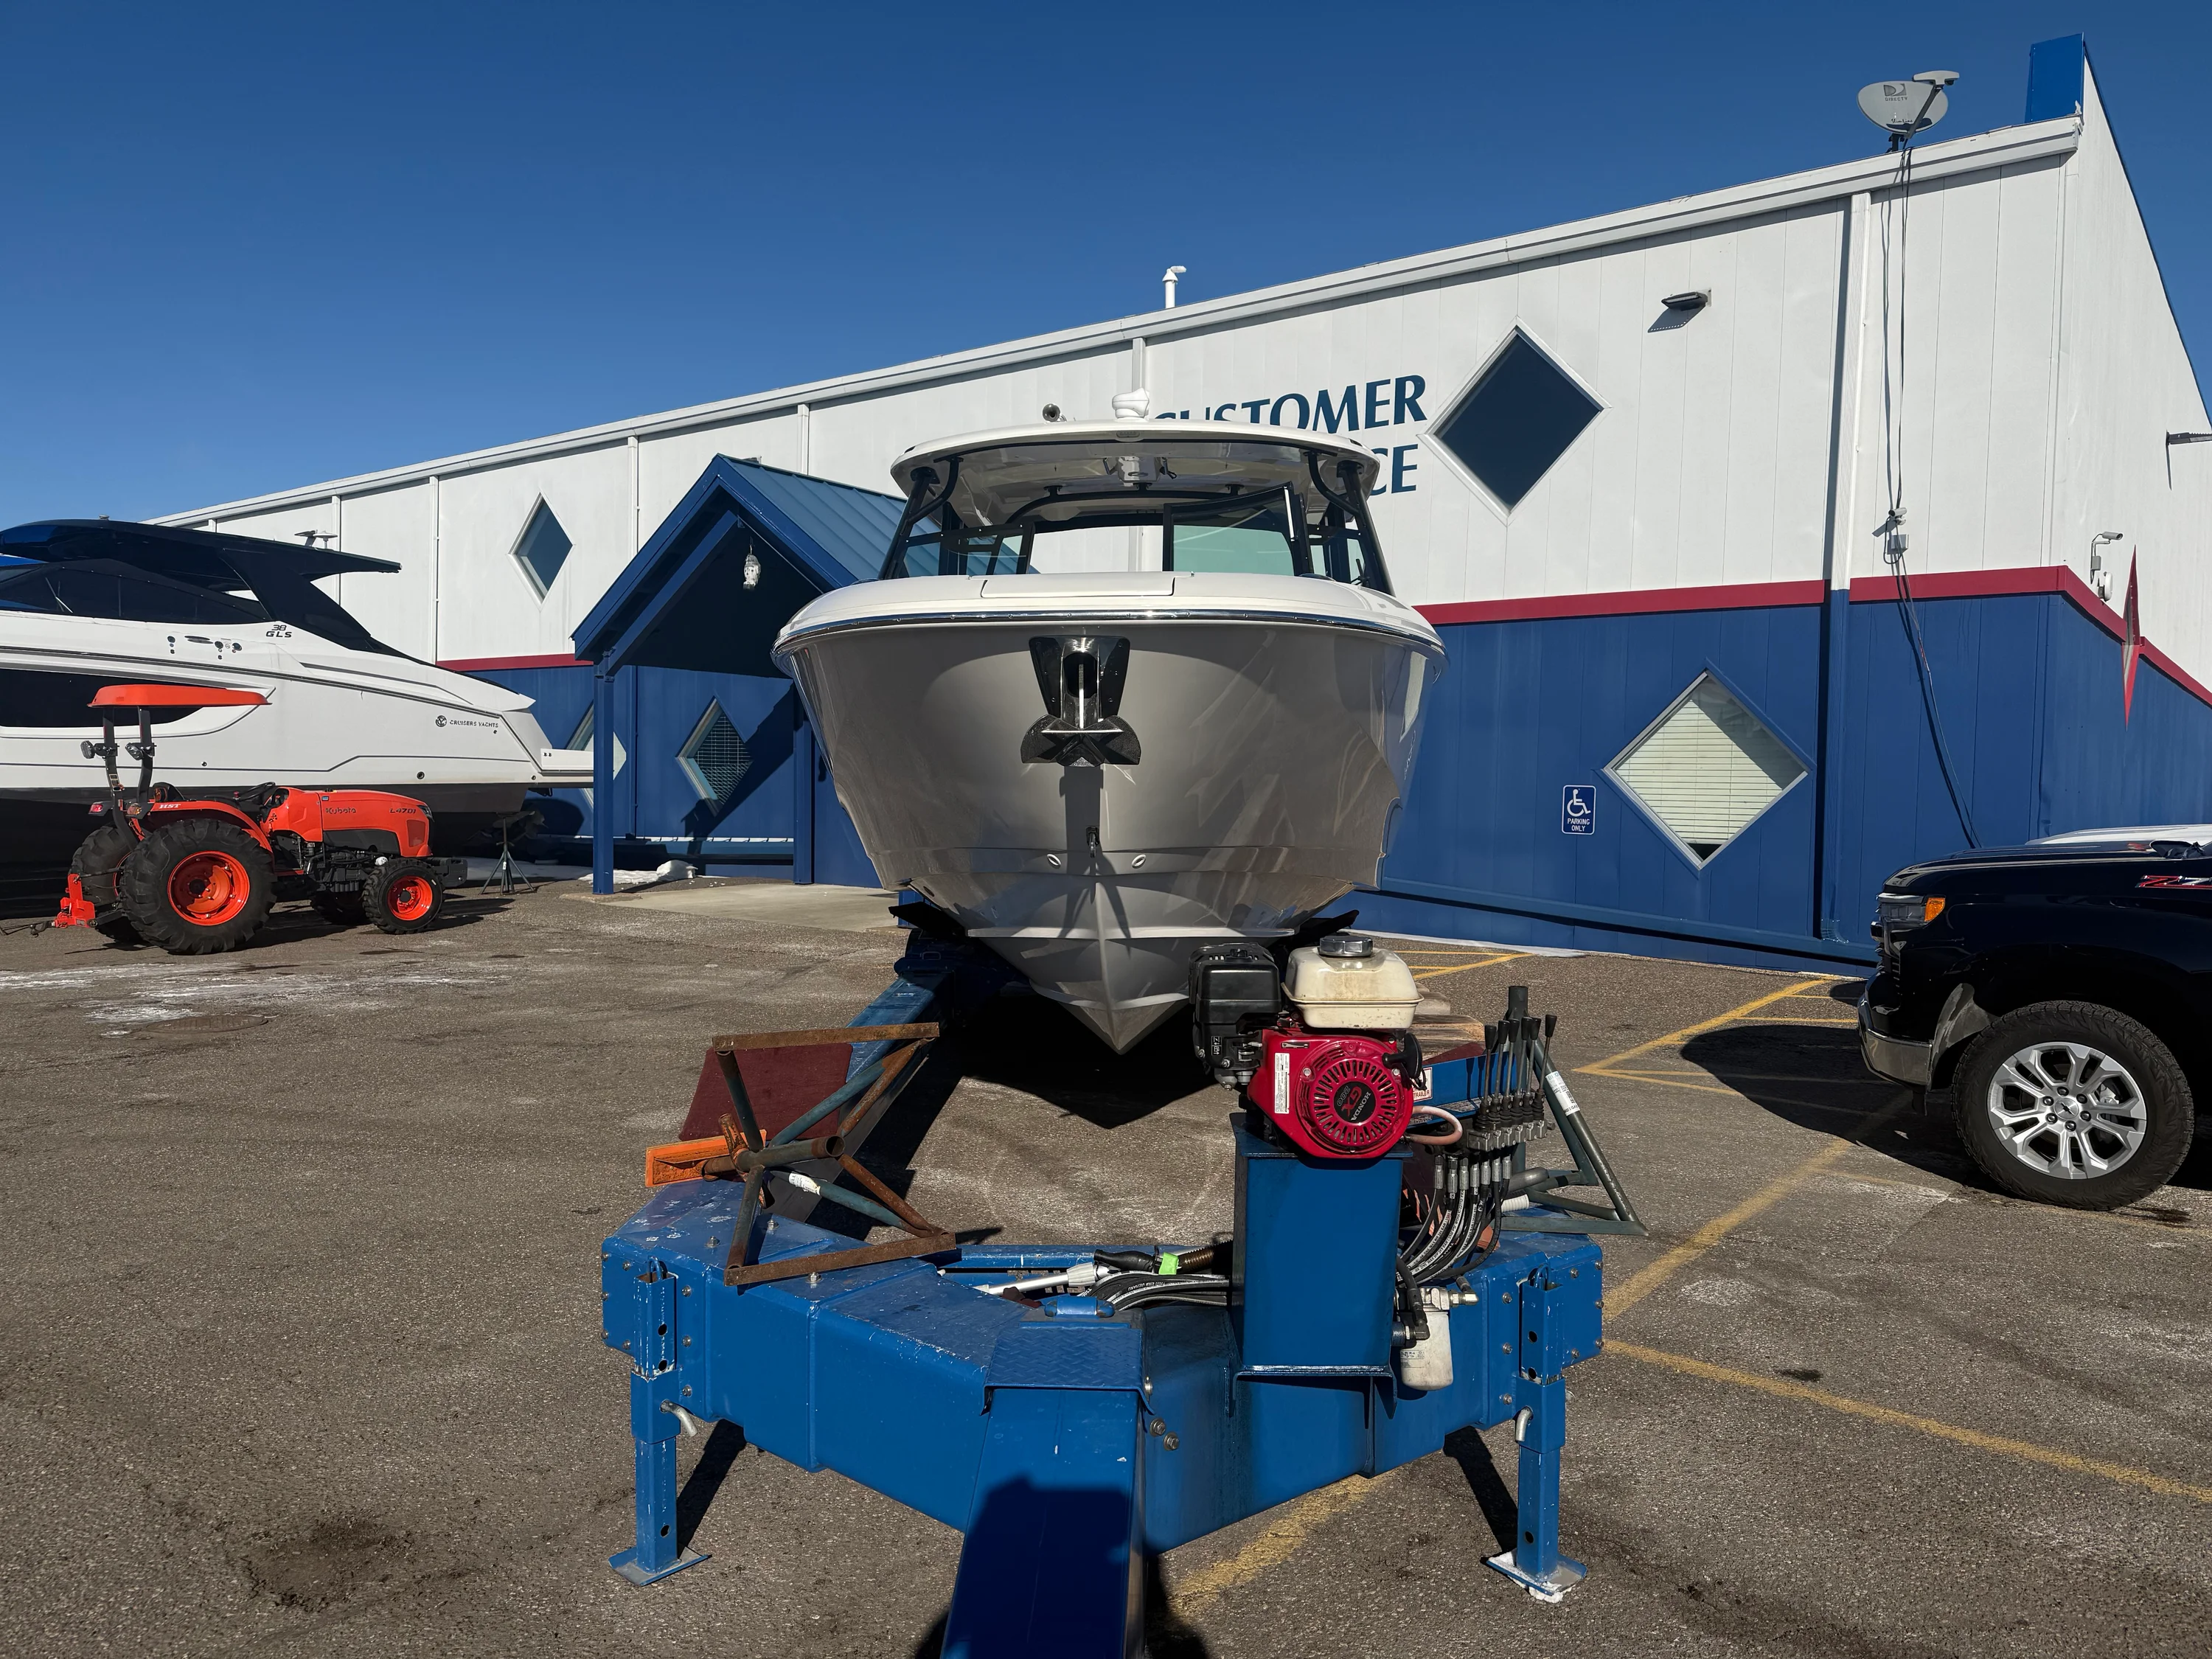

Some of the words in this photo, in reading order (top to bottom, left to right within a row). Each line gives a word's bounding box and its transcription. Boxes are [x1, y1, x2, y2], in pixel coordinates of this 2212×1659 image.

[1155, 374, 1427, 434] TOMER
[2135, 874, 2212, 889] Z7
[1336, 1085, 1351, 1106] 200
[1341, 1085, 1362, 1117] GX
[1350, 1091, 1371, 1121] HONDA
[1413, 1090, 1430, 1099] TRAILER
